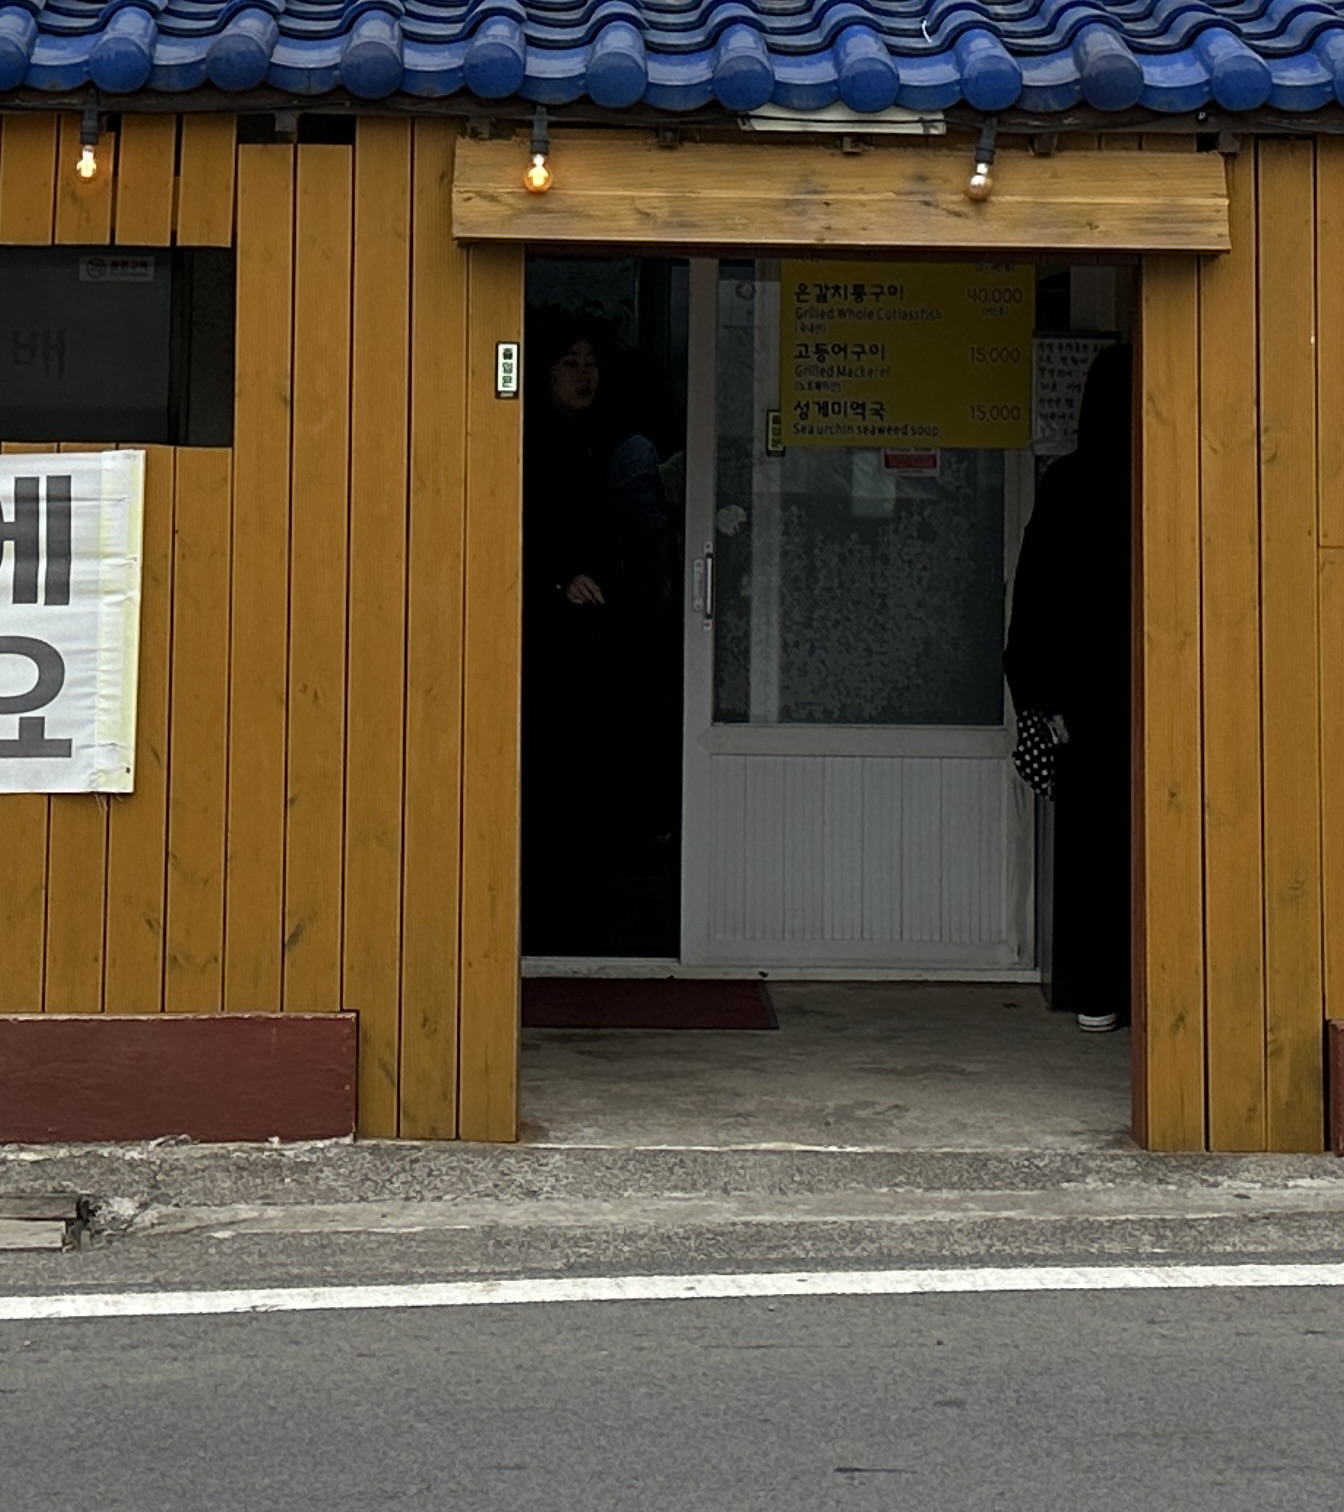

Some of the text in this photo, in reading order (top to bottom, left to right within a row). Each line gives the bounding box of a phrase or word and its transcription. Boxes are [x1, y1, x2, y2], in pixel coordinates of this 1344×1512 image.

[795, 307, 834, 320] Grilled
[837, 308, 874, 320] Whole
[794, 343, 885, 363] 고등어구이
[970, 347, 1021, 364] 15,000
[795, 364, 890, 378] Grilled Mackerel
[794, 400, 886, 421] 성게미역국
[970, 404, 1021, 422] 15,000
[793, 422, 941, 437] Sea urchin seaweed soup
